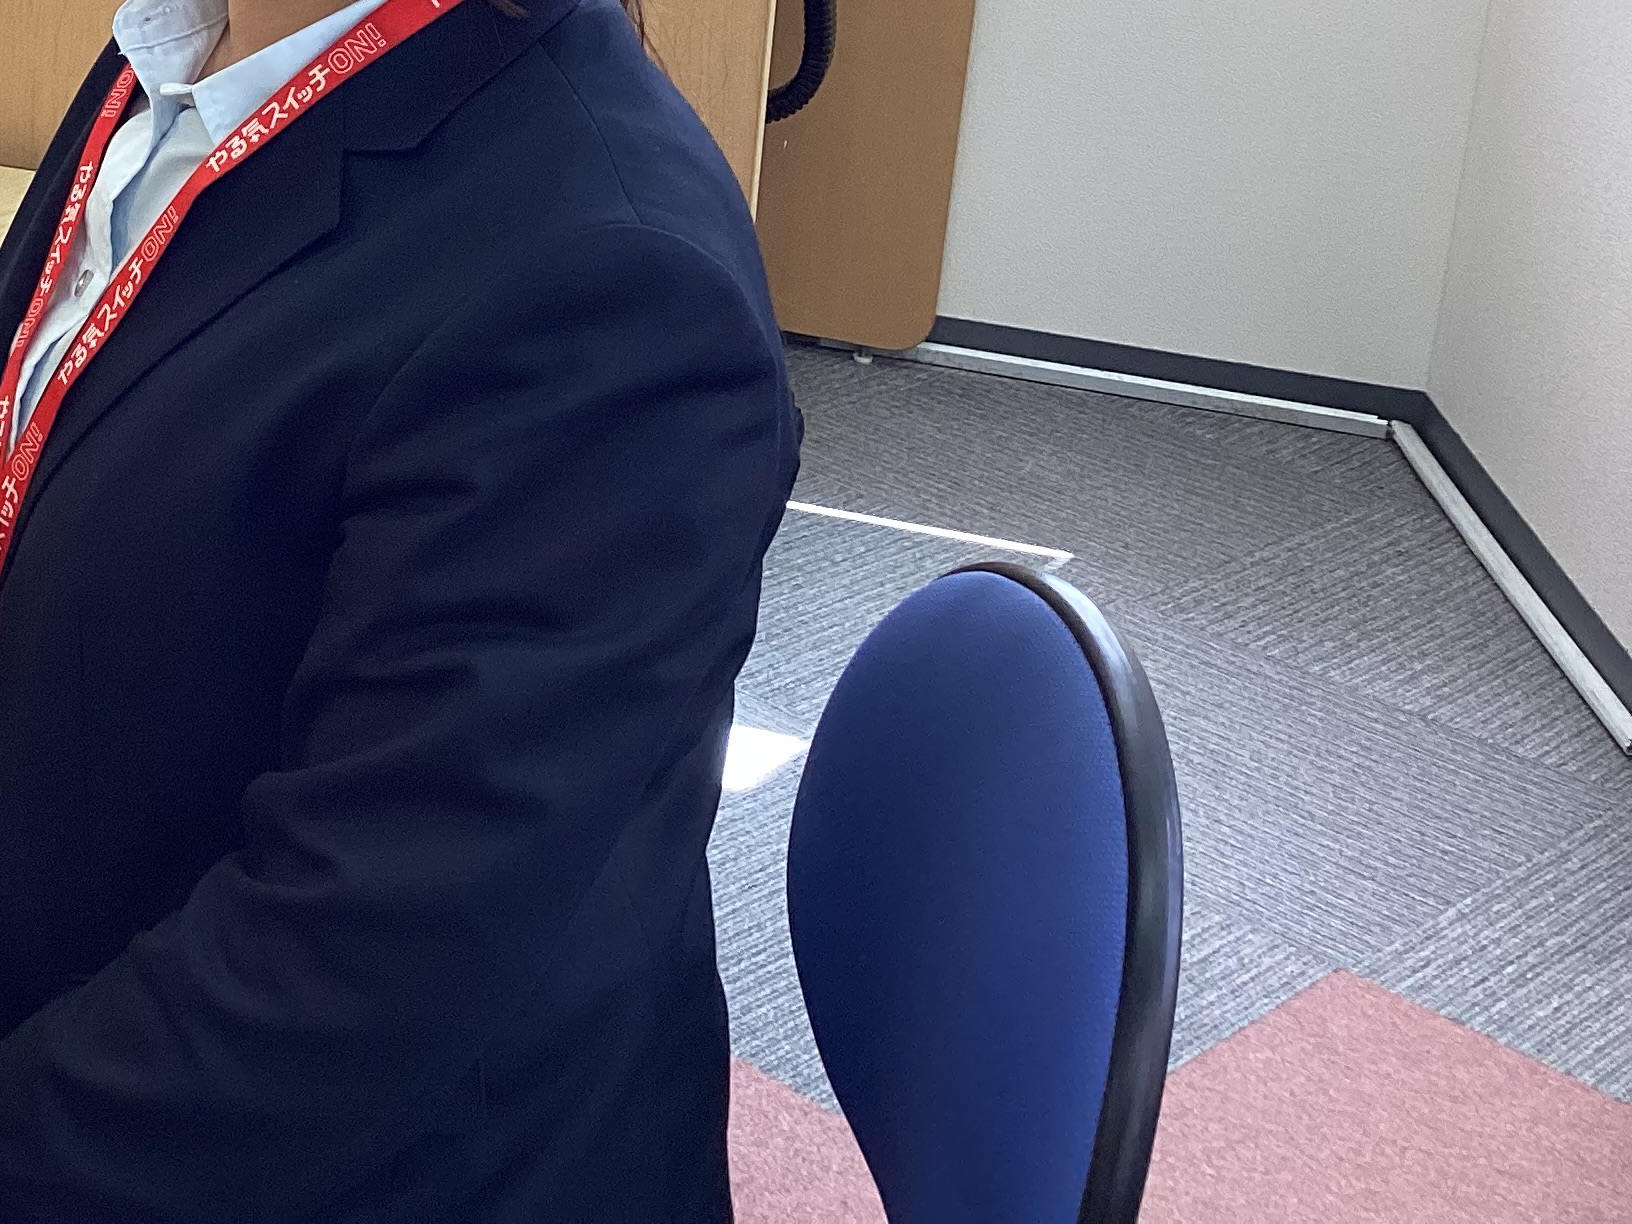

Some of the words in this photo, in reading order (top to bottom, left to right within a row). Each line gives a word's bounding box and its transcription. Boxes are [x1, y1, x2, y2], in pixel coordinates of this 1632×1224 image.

[205, 21, 388, 175] やる気スイッチON!
[57, 205, 179, 386] やる気スイッチON!
